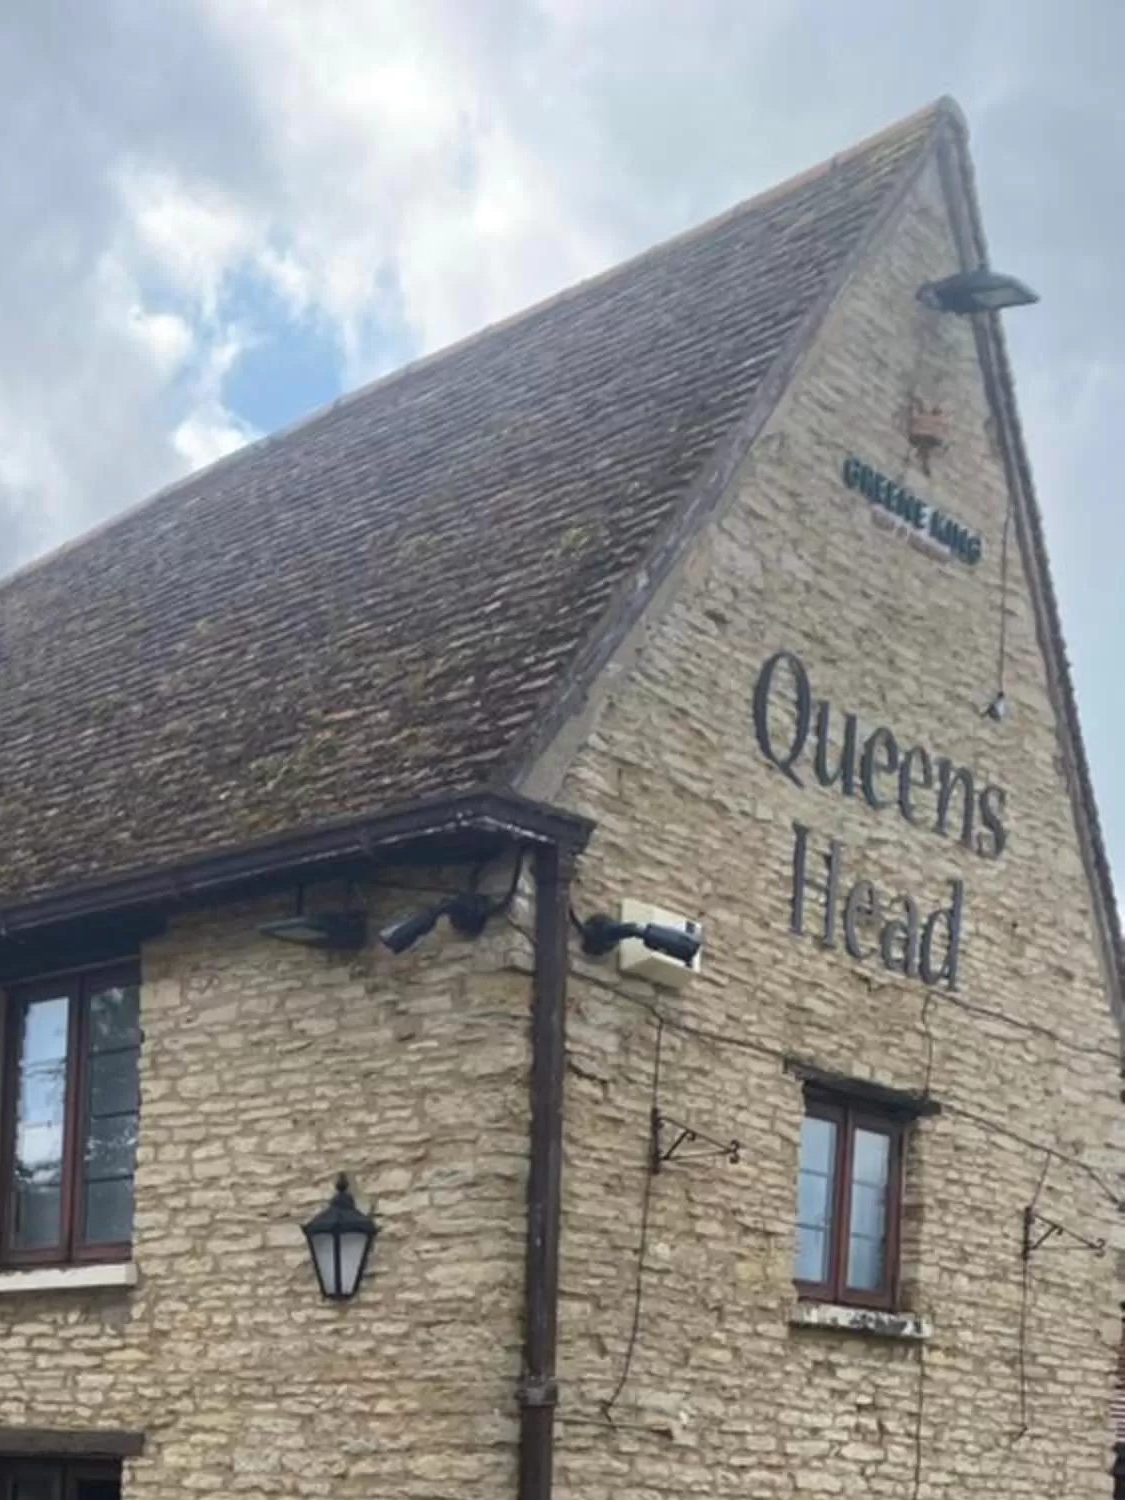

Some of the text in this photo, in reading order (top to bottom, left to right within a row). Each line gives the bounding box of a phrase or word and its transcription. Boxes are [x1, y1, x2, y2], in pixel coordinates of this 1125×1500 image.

[842, 456, 927, 530] GREENE
[929, 509, 982, 566] KING
[752, 649, 1009, 860] Queens
[788, 820, 964, 993] Head
